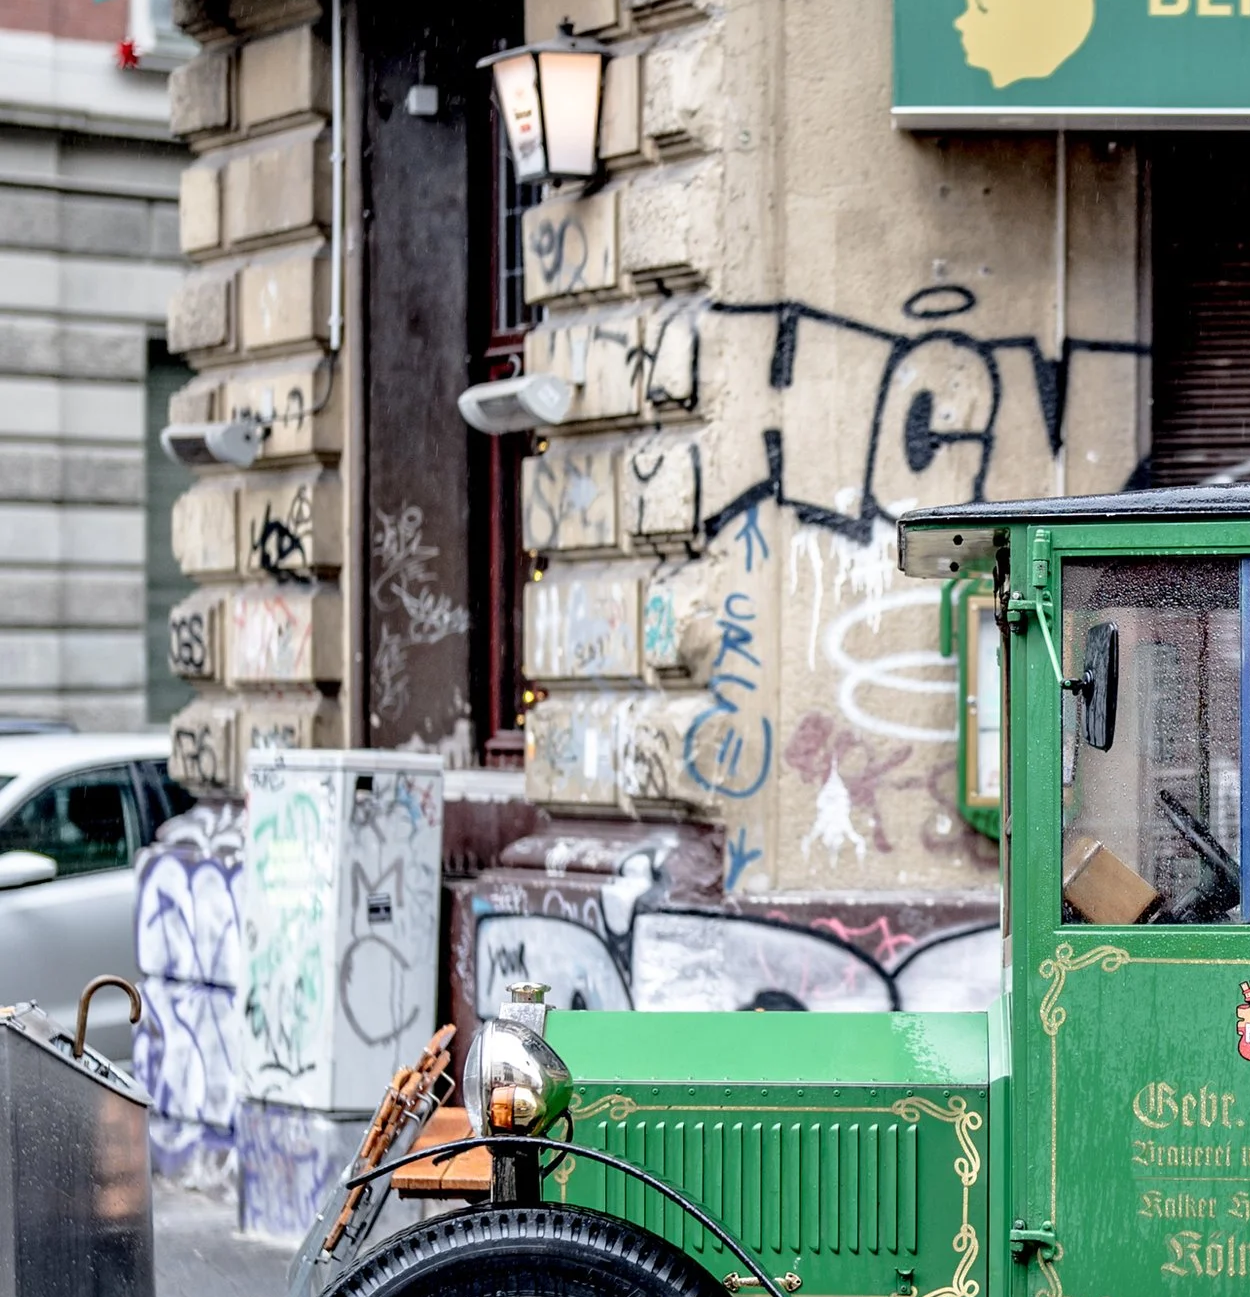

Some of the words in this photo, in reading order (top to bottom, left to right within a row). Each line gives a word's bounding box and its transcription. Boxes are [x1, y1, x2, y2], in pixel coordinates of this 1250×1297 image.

[1132, 1080, 1246, 1129] Gebr.
[1131, 1139, 1232, 1168] Brauerei
[1138, 1189, 1217, 1220] Kalker
